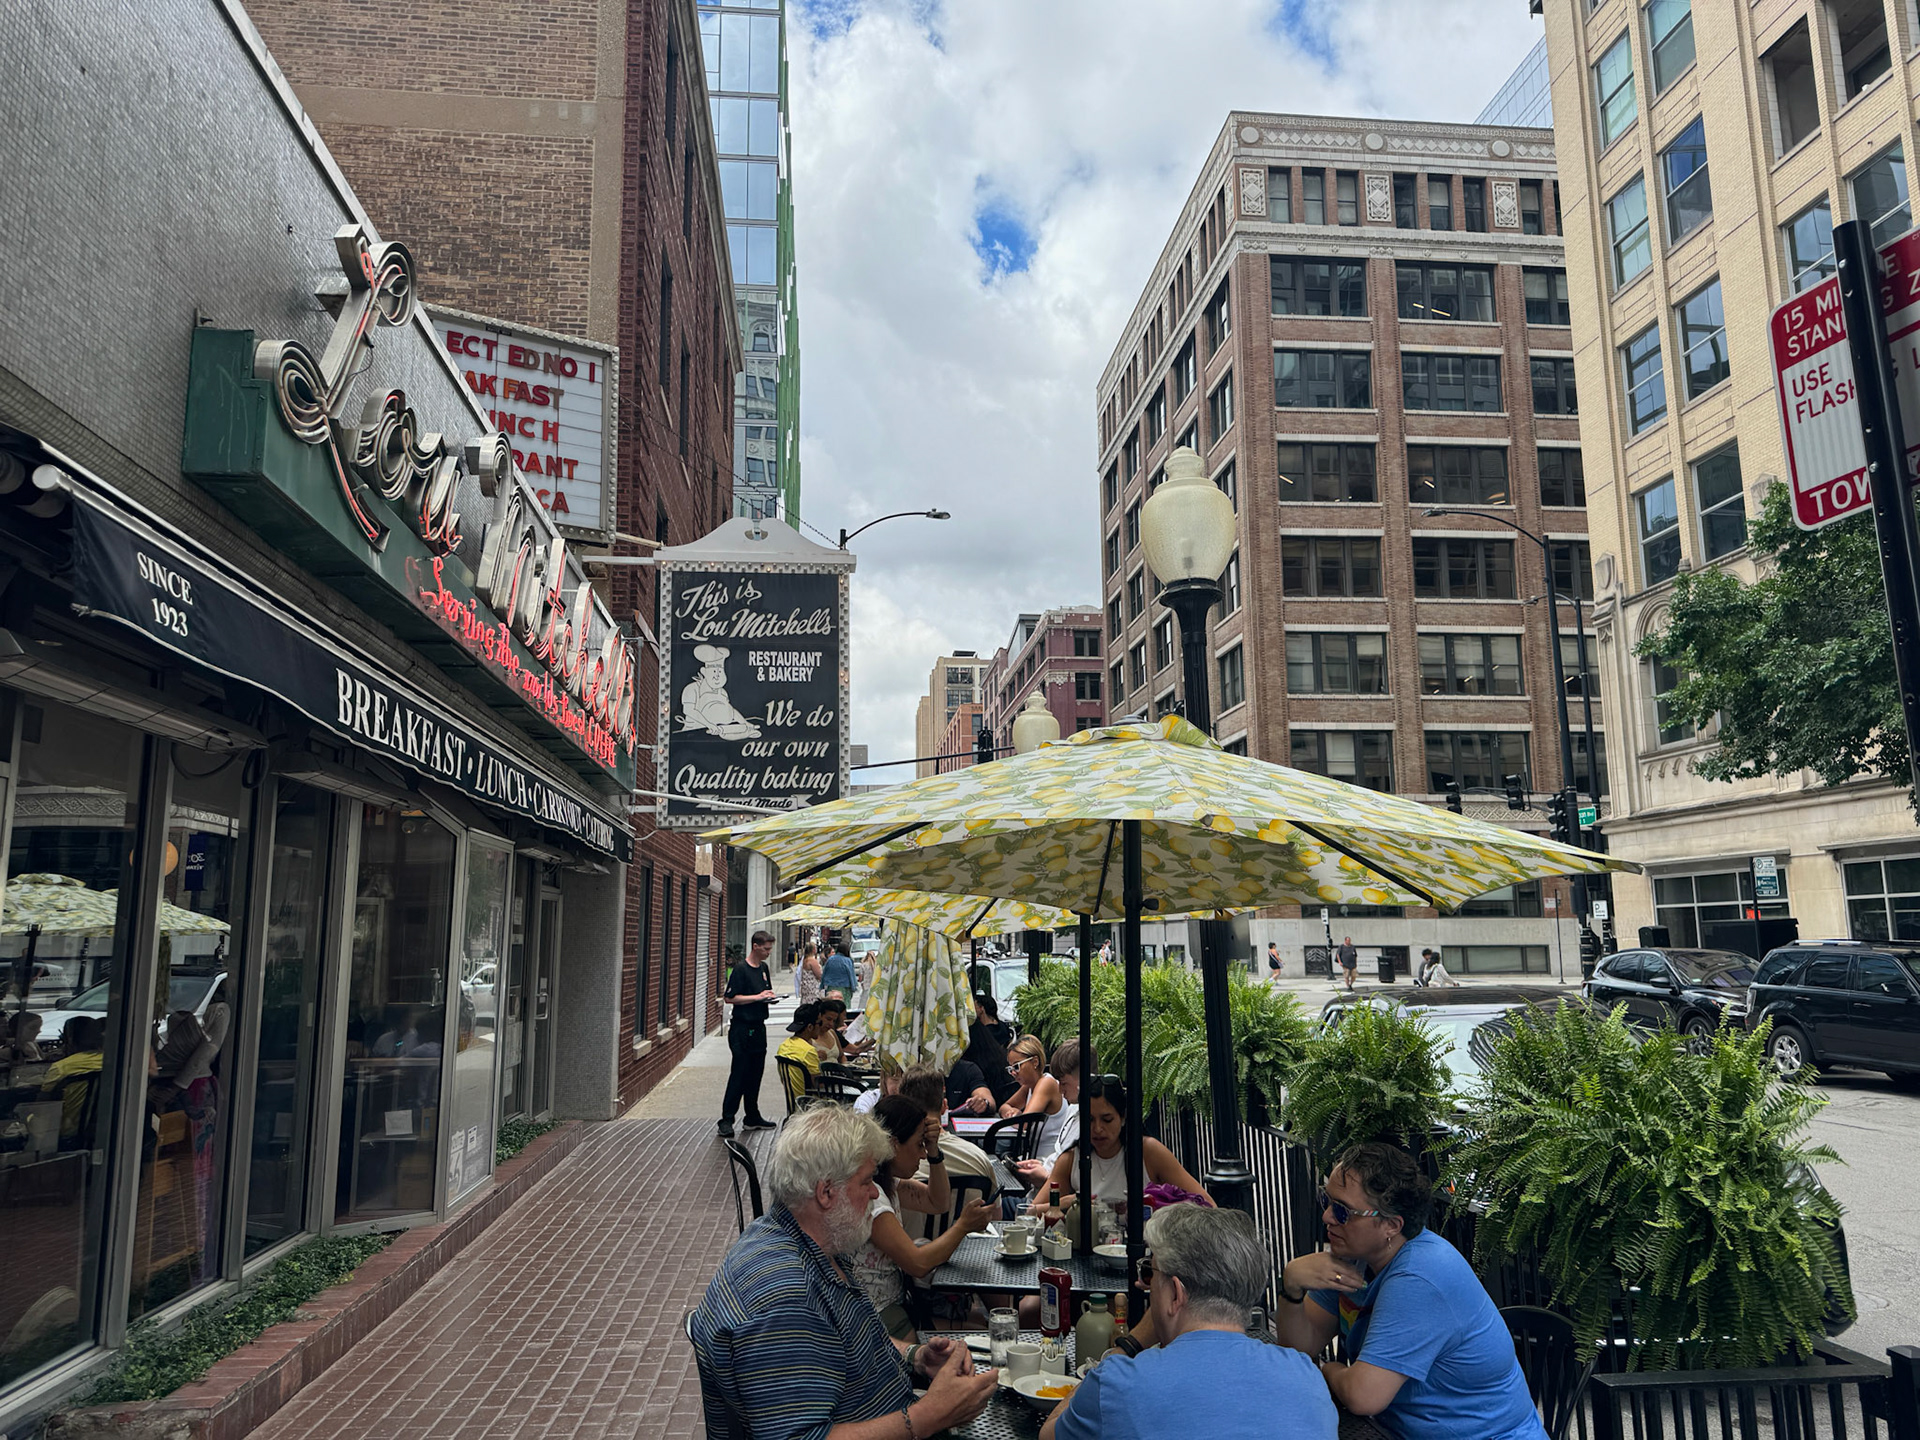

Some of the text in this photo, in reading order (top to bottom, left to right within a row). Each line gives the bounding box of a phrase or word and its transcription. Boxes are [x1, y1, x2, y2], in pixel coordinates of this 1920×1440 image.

[1783, 306, 1804, 334] 15
[254, 224, 462, 558] Lou
[1792, 362, 1832, 397] USE
[532, 488, 570, 514] CA
[137, 551, 194, 605] SINCE
[418, 556, 496, 660] Serving
[675, 577, 762, 618] This is
[151, 598, 188, 637] 1923
[681, 606, 836, 642] Lou Mitchells
[748, 651, 822, 667] RESTAURANT
[757, 667, 815, 682] & BAKERY
[765, 699, 834, 727] We do
[336, 668, 465, 780] BREAKFAST
[475, 751, 528, 808] LUNCH
[741, 740, 830, 758] our own
[674, 763, 835, 796] Quality baking
[755, 798, 792, 808] Made
